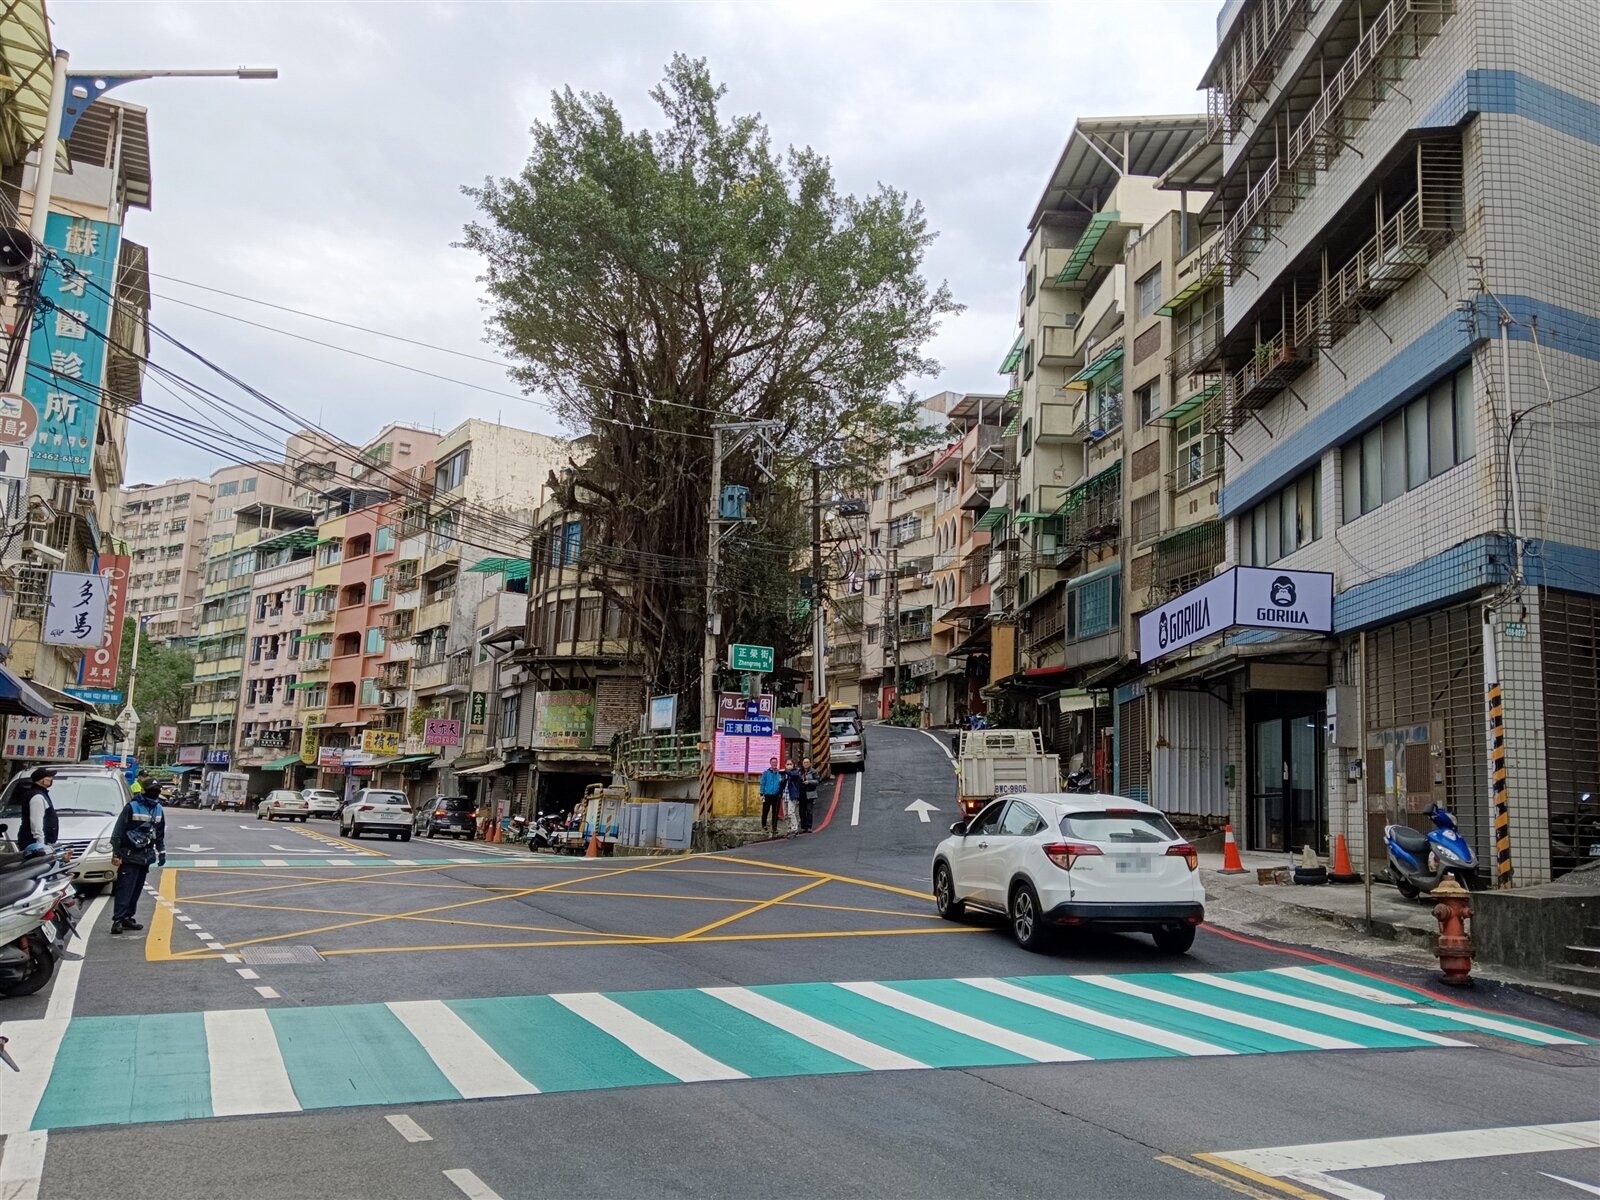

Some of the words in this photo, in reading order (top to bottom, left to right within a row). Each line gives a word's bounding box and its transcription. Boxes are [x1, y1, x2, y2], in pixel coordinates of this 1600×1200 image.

[44, 226, 100, 425] 蘇牙醫診所
[0, 418, 28, 437] 島2
[70, 579, 93, 640] 多馬
[738, 647, 769, 659] 正榮街
[720, 697, 771, 713] 旭丘園
[726, 722, 761, 733] 正濱國中
